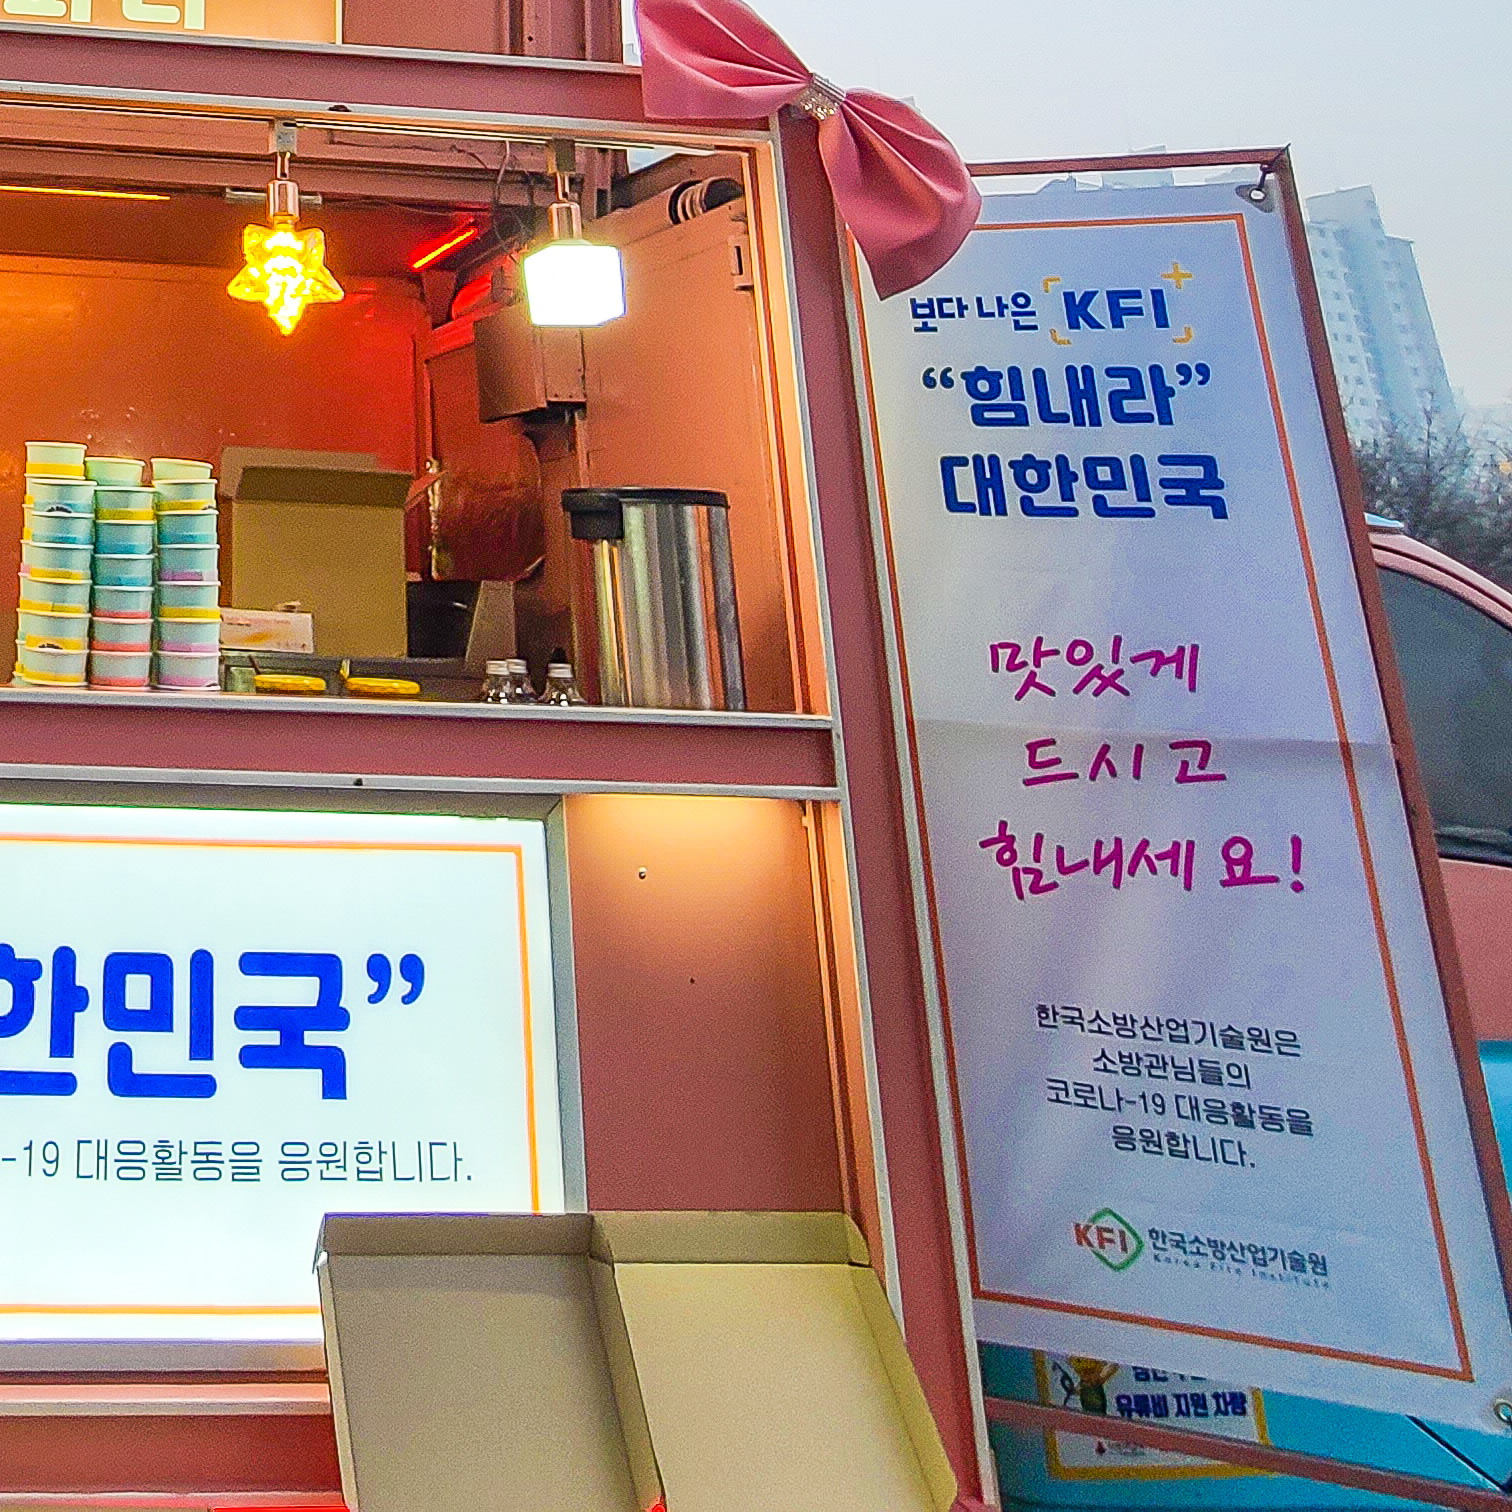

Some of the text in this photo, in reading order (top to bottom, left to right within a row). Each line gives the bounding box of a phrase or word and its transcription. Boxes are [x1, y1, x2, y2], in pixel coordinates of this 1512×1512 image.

[910, 289, 1169, 332] 보다 나은 KFI
[940, 454, 1228, 519] 대한민국
[990, 635, 1199, 701] 맛있게
[1023, 738, 1226, 786] 드시고
[979, 820, 1304, 900] 힘내세요!
[1036, 1004, 1301, 1057] 한국소방산업기술원은
[1092, 1047, 1252, 1090] 소방관님들의
[1046, 1078, 1314, 1136] 코로나-19 대응활동을
[77, 1139, 262, 1181] 대응활동을
[279, 1141, 471, 1182] 응원합니다.
[1111, 1124, 1256, 1168] 응원합니다.
[1074, 1223, 1128, 1253] KFI
[1148, 1228, 1328, 1276] 한국소방산업기술원
